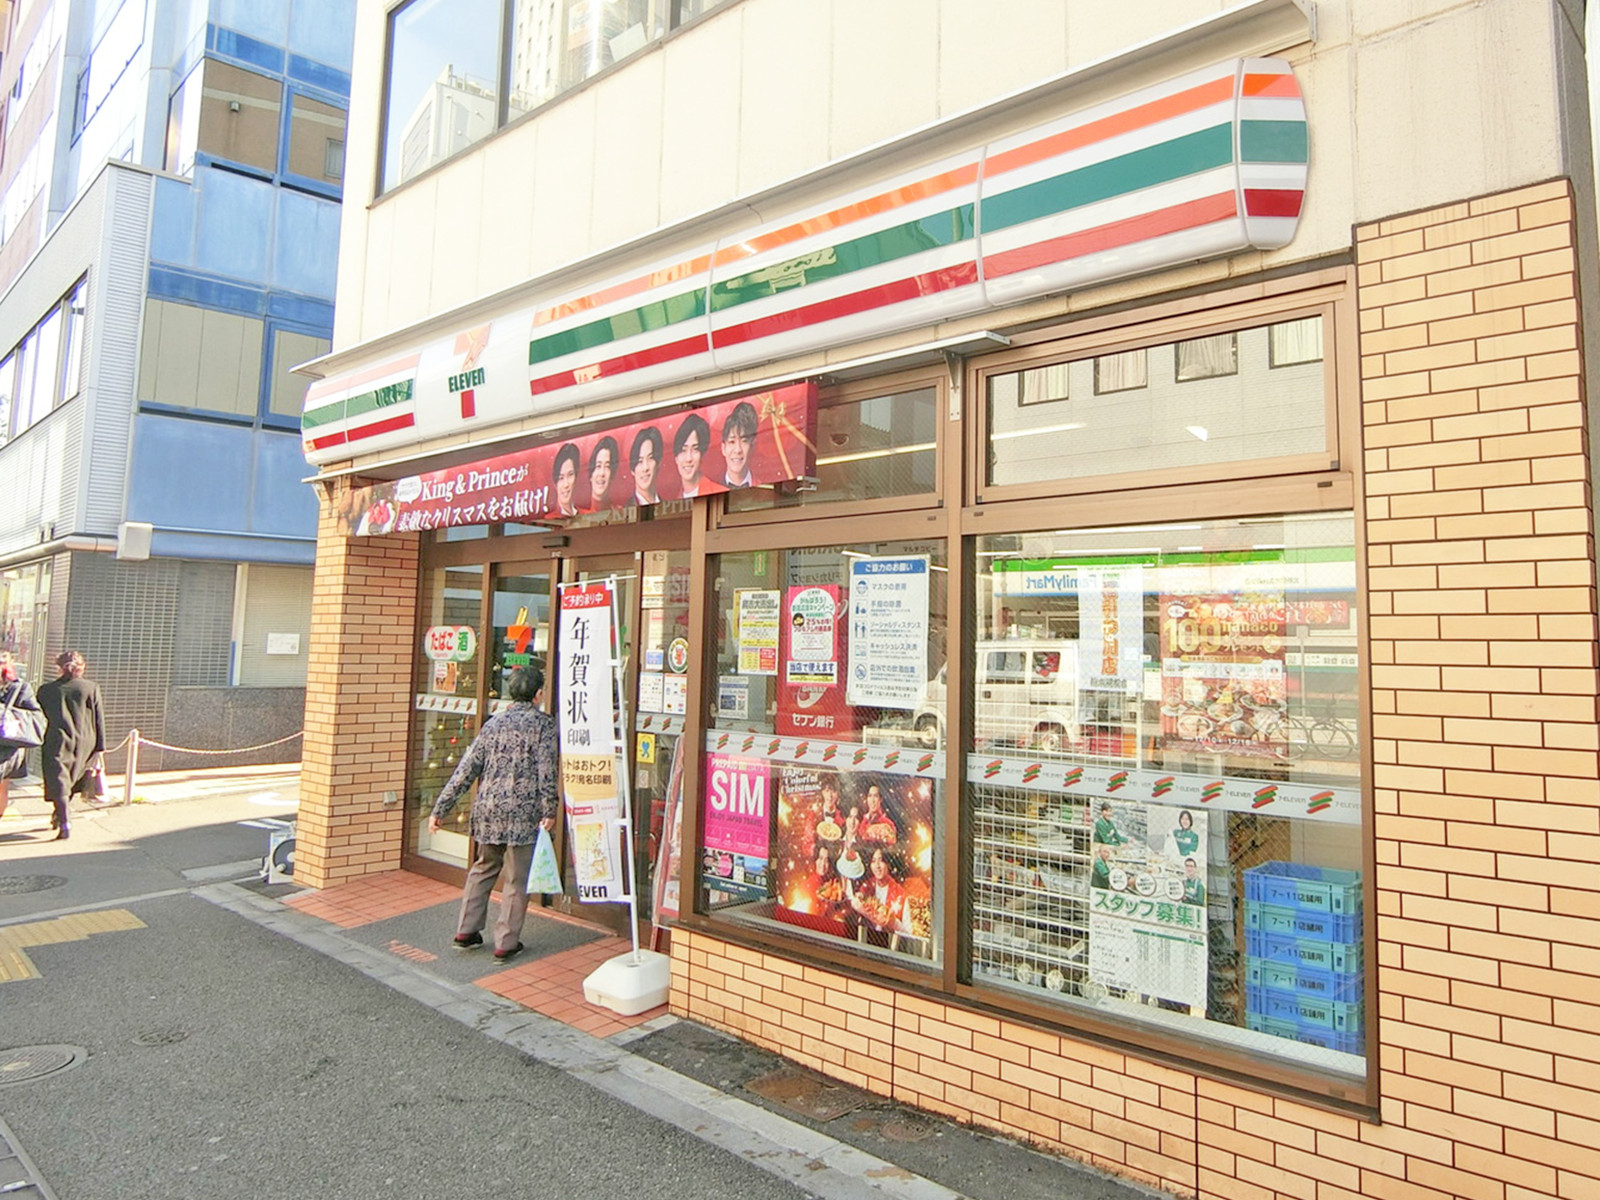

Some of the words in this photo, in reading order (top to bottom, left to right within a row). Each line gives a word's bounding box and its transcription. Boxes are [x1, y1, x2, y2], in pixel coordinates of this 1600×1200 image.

[430, 631, 454, 652] たばこ
[458, 631, 469, 652] 酒
[567, 616, 590, 724] 年賀状
[792, 713, 835, 729] セブン銀行
[567, 729, 591, 746] 印刷
[710, 769, 765, 818] SIM
[1094, 891, 1203, 930] スタッフ募集!
